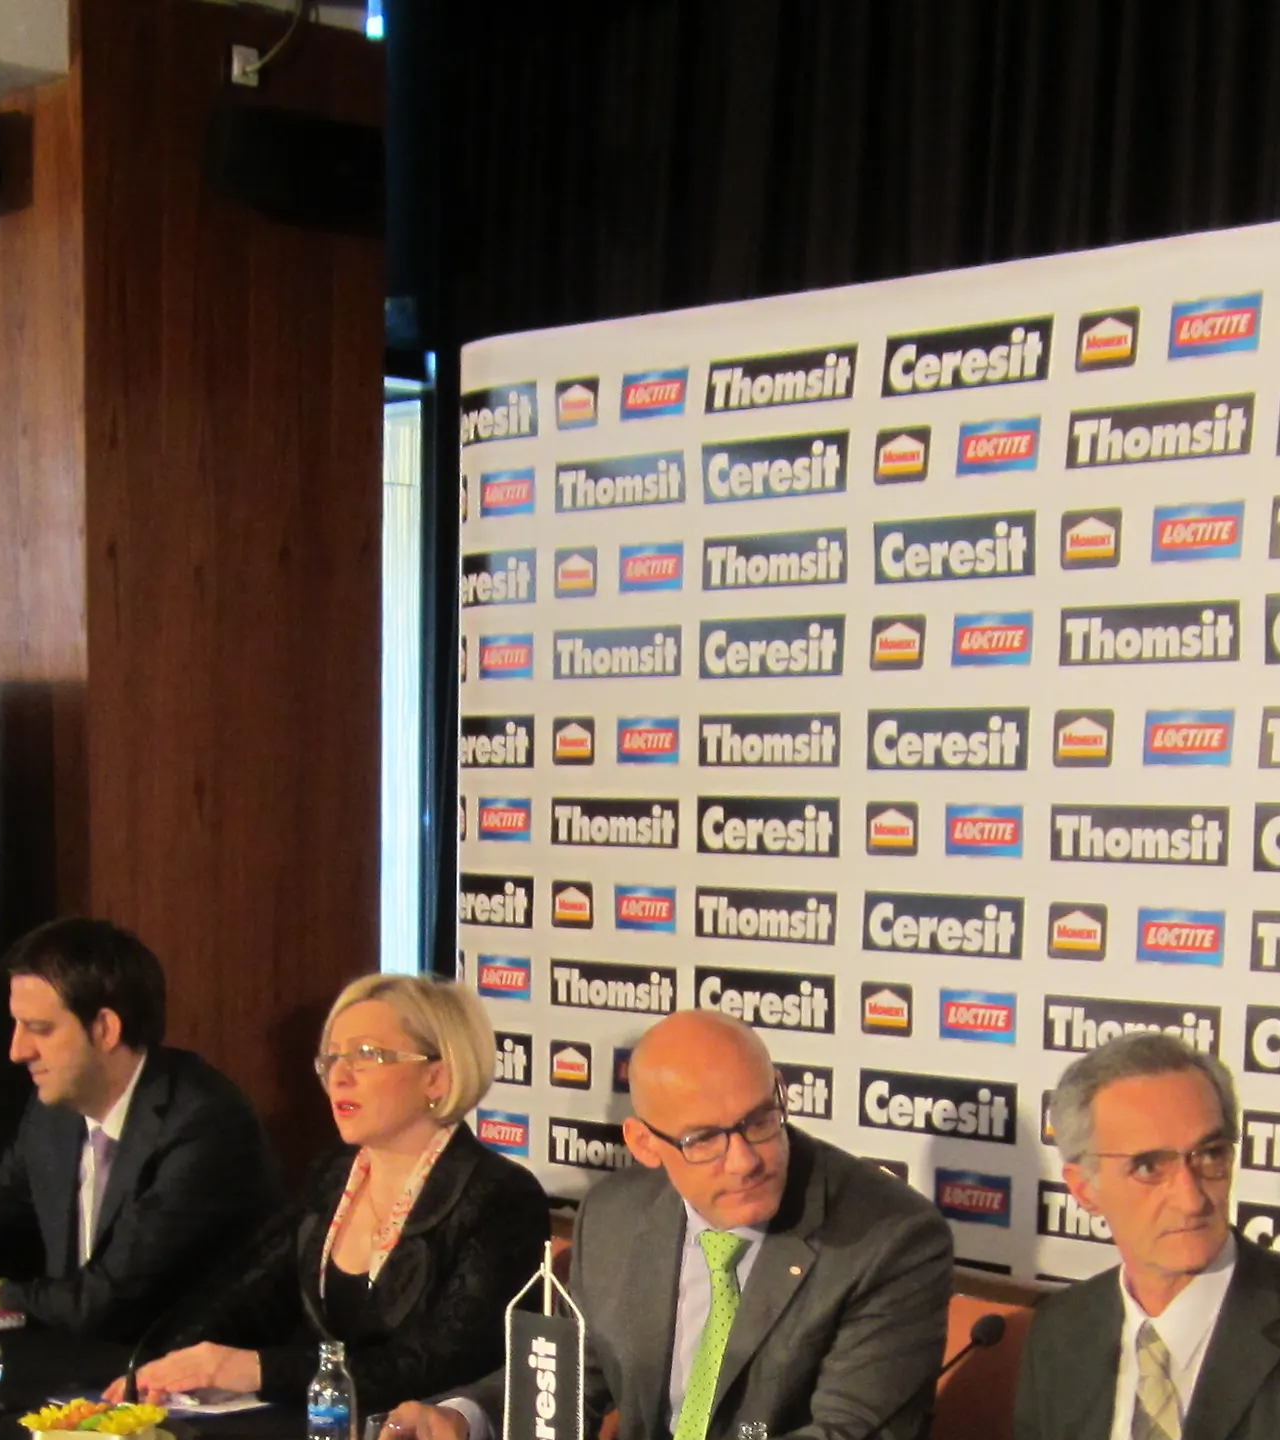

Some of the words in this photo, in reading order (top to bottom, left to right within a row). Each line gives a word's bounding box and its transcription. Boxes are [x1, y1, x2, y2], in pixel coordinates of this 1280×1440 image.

[711, 355, 851, 410] Thomsit
[889, 328, 1042, 391] Ceresit
[1074, 405, 1246, 464] Thomsit
[558, 461, 680, 509] Thomsit
[708, 441, 840, 498] Ceresit
[708, 538, 842, 585] Thomsit
[880, 522, 1028, 579] Ceresit
[558, 635, 678, 676] Thomsit
[705, 624, 838, 674] Ceresit
[1065, 611, 1232, 660] Thomsit
[702, 722, 835, 764] Thomsit
[874, 716, 1020, 766] Ceresit
[555, 805, 676, 844] Thomsit
[702, 806, 832, 850] Ceresit
[1056, 814, 1222, 861] Thomsit
[699, 898, 831, 940] Thomsit
[869, 902, 1015, 953] Ceresit
[554, 968, 674, 1010] Thomsit
[865, 1081, 1009, 1139] Ceresit
